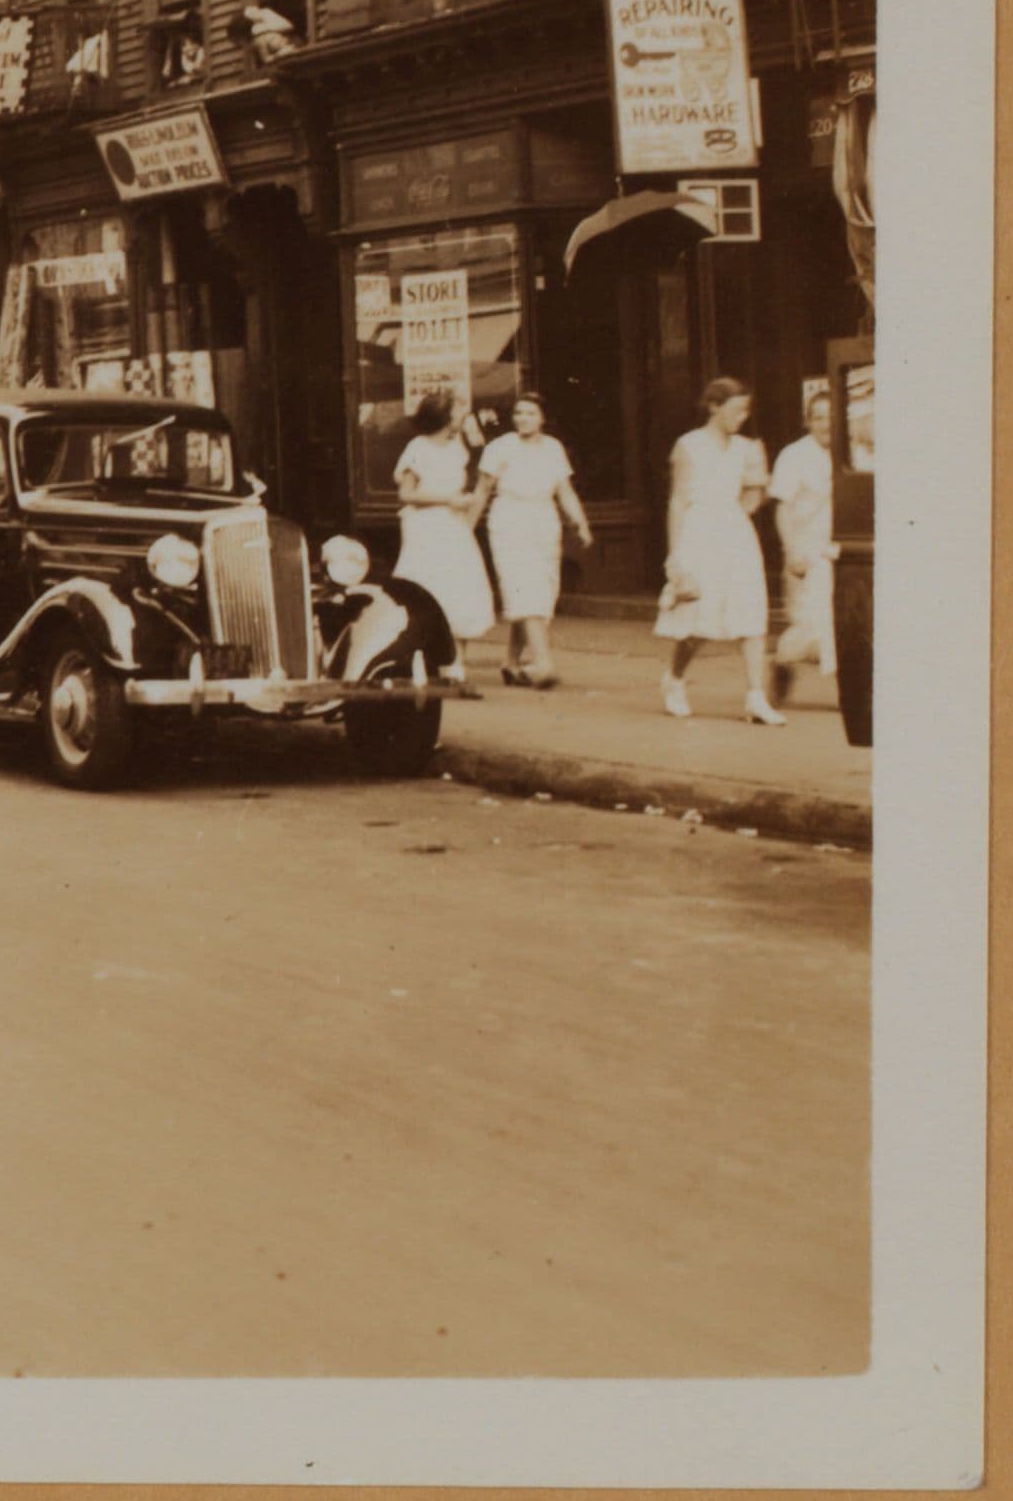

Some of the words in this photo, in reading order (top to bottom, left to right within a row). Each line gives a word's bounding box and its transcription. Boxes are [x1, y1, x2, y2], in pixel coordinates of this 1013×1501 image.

[633, 101, 740, 125] HARDWARE
[174, 160, 213, 181] PRICES
[406, 278, 462, 304] STORE
[407, 319, 427, 342] TO
[429, 318, 462, 342] LET
